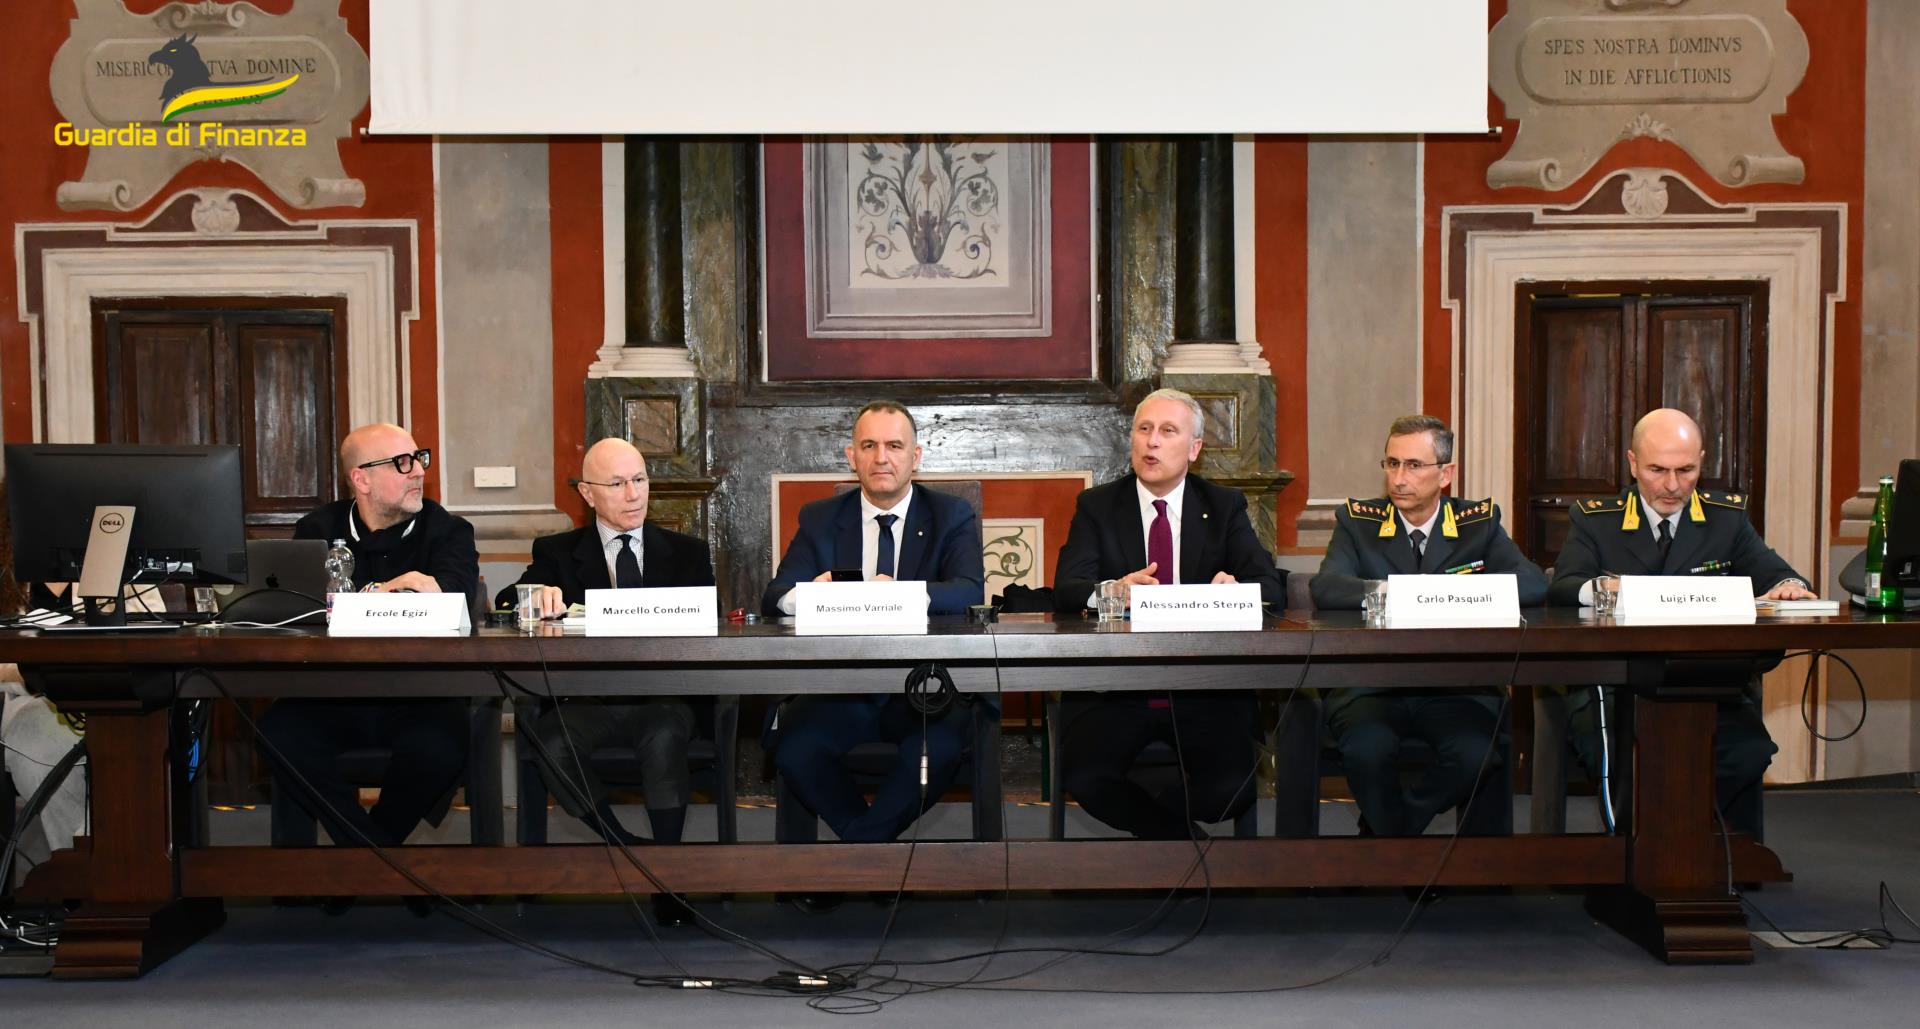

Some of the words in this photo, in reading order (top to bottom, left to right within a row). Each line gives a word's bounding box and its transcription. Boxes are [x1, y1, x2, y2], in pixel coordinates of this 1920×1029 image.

[1544, 39, 1585, 55] SPES
[1594, 38, 1659, 55] NOSTRA
[1669, 37, 1742, 54] DOMINVS
[96, 61, 171, 77] MISERICO
[207, 60, 238, 75] TVA
[247, 58, 316, 75] DOMINE
[1564, 69, 1582, 85] IN
[1589, 69, 1616, 86] DIE
[1624, 67, 1732, 85] AFFLICTIONIS
[1139, 600, 1209, 609] Alessandro
[1212, 600, 1253, 610] Sterpa
[1416, 594, 1445, 604] Carlo
[1447, 594, 1492, 605] Pasquali
[1660, 594, 1687, 605] Luigi
[1689, 594, 1717, 603] Falce
[365, 609, 399, 617] Ercole
[401, 609, 428, 618] Egizi
[602, 606, 650, 615] Marcello
[653, 605, 700, 614] Condemi
[816, 604, 861, 613] Massimo
[864, 603, 903, 612] Varriale
